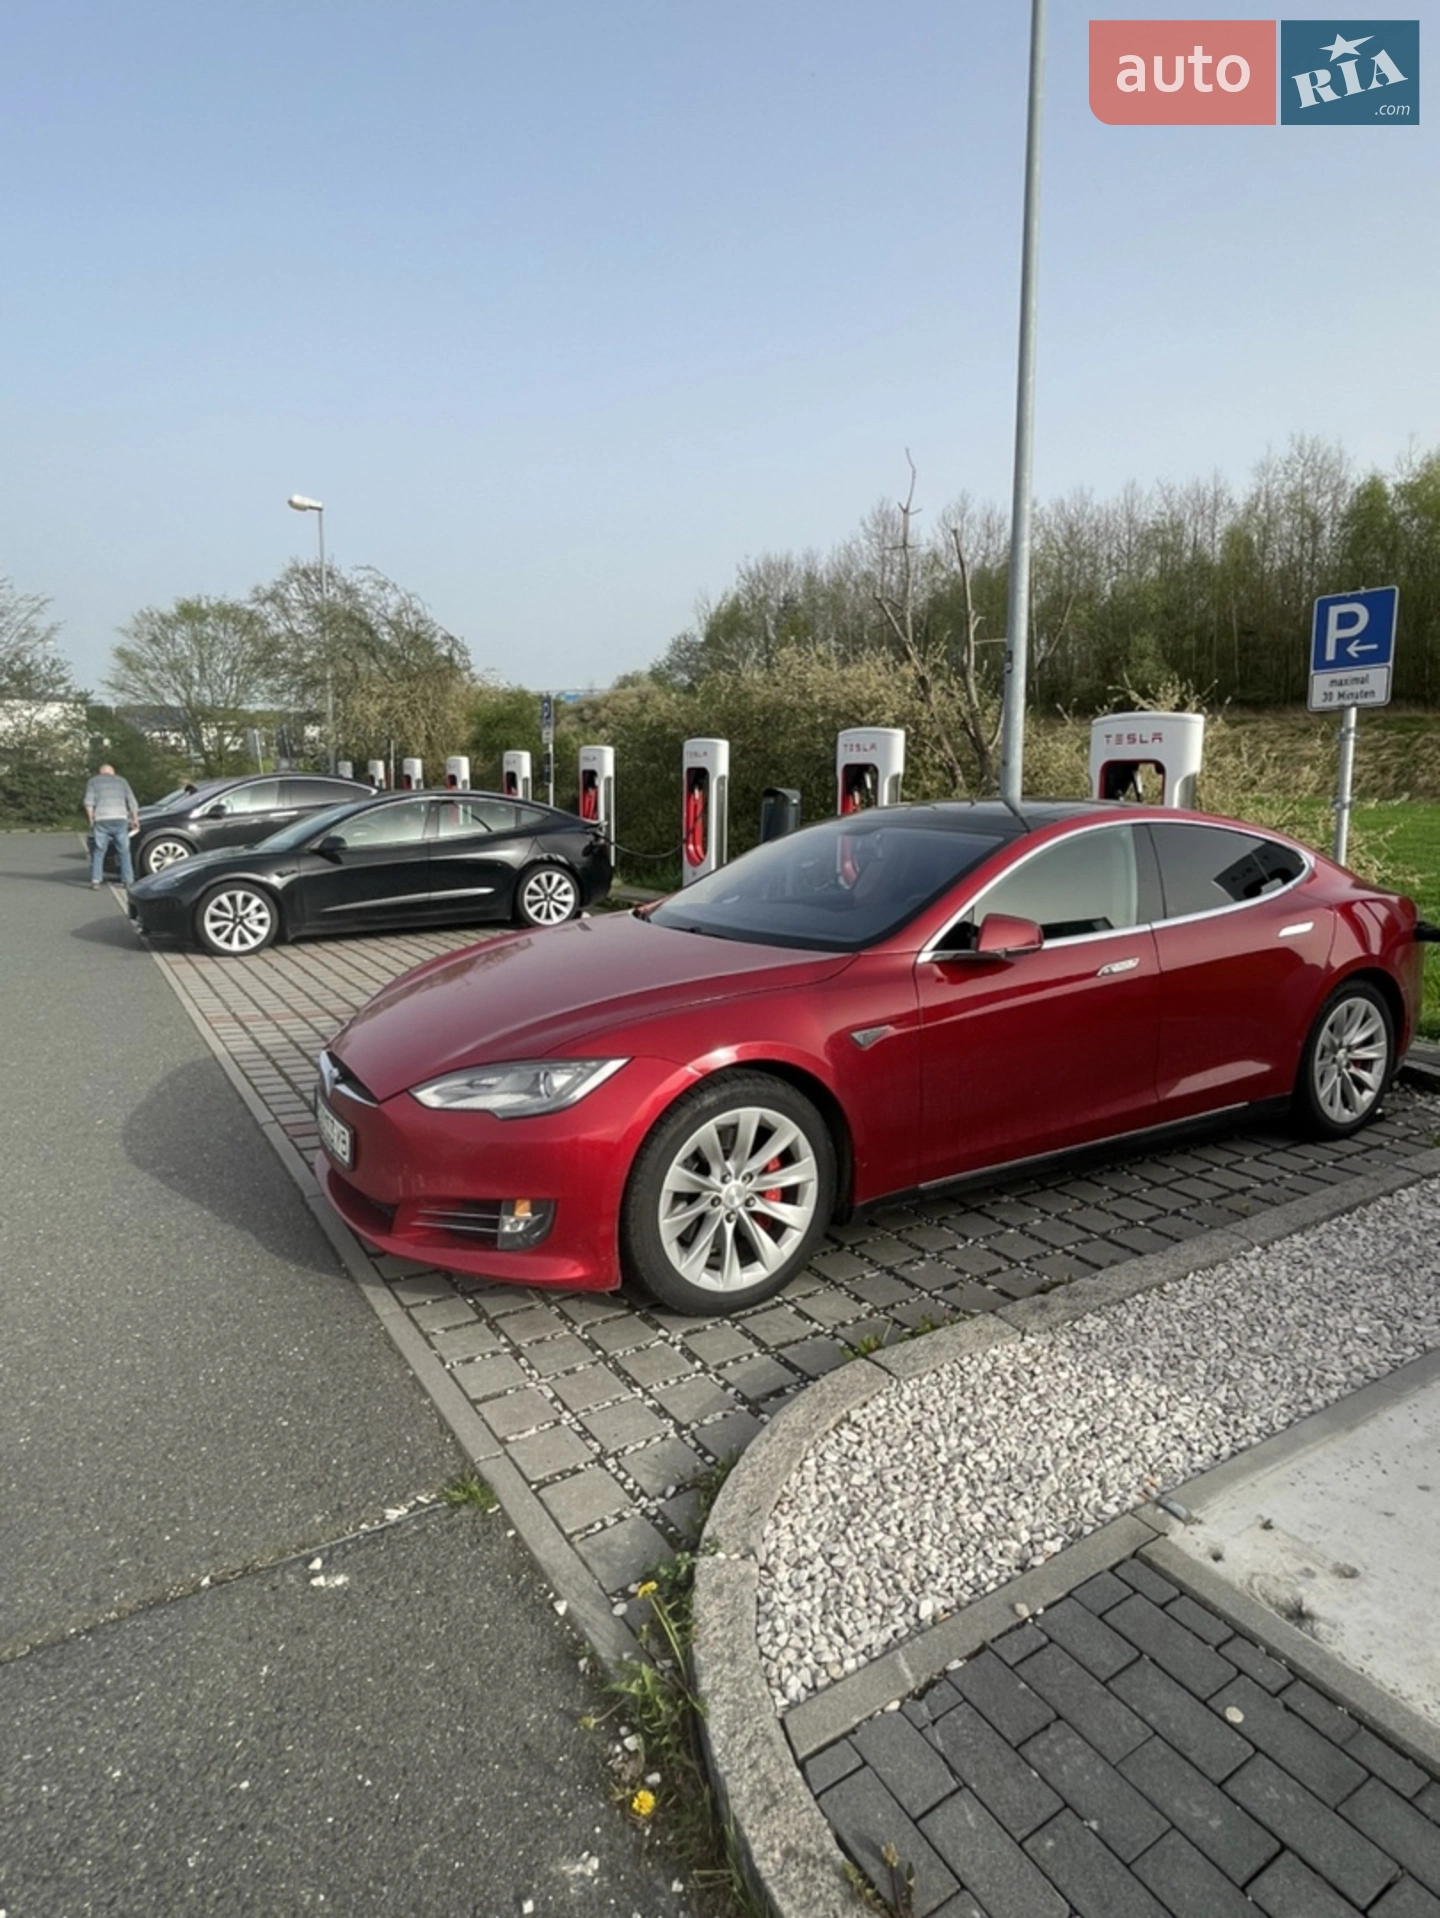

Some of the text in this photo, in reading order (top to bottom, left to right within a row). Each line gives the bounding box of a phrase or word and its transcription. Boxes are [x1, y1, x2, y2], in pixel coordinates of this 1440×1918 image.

[1325, 602, 1369, 661] P
[1329, 673, 1370, 687] maximal
[1337, 690, 1376, 700] Minuten
[1104, 732, 1163, 745] TESLA
[843, 743, 877, 752] TESLA
